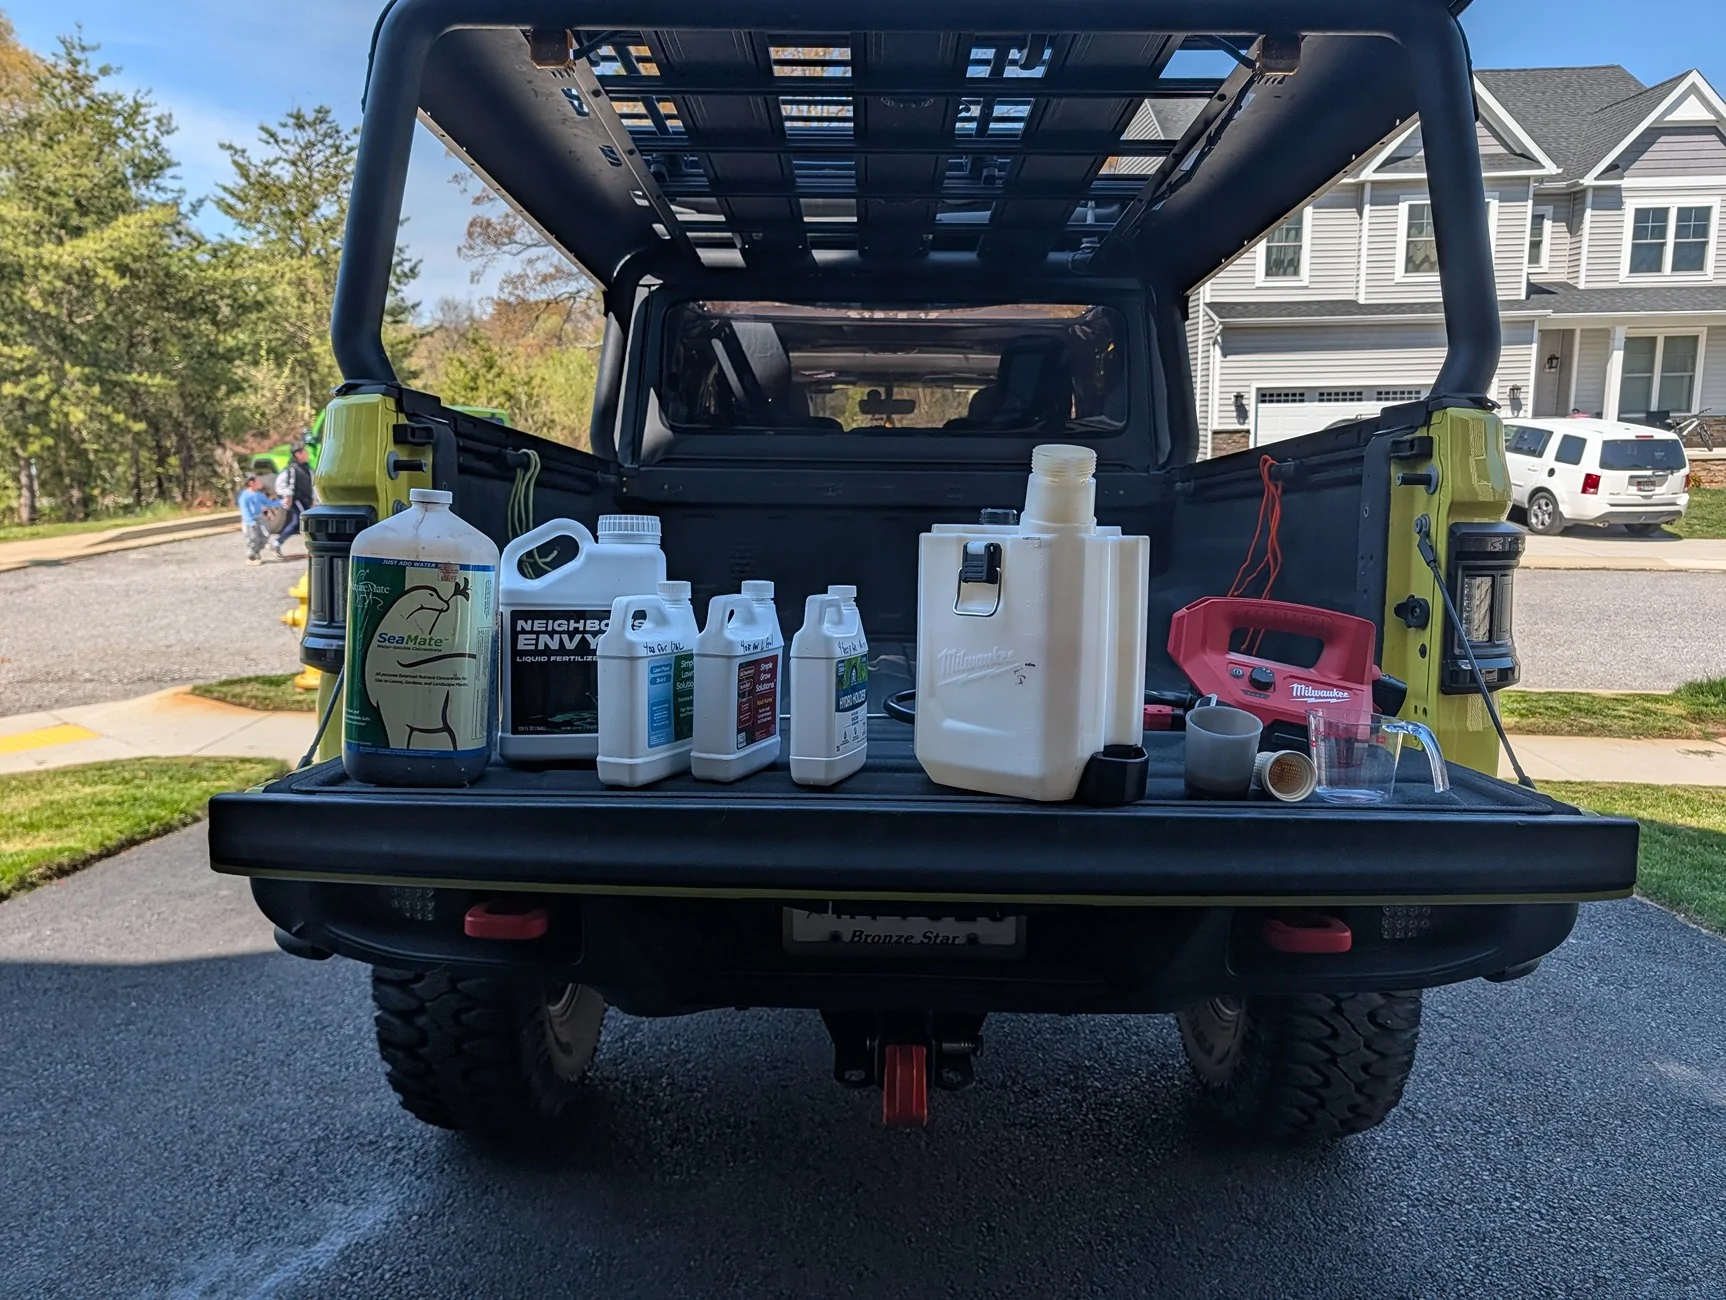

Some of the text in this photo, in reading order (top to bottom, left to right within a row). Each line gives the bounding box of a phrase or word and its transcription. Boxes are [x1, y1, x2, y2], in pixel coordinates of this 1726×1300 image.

[516, 634, 600, 650] ENVY
[680, 660, 694, 668] Simp
[760, 661, 773, 671] Simple
[937, 646, 1016, 678] Milwaukee
[760, 672, 771, 681] Grow
[676, 681, 694, 690] Solutio
[755, 681, 775, 692] Solutions
[1289, 683, 1350, 698] Milwaukee
[840, 694, 853, 710] HYDRO
[850, 930, 960, 945] Bronze Star
